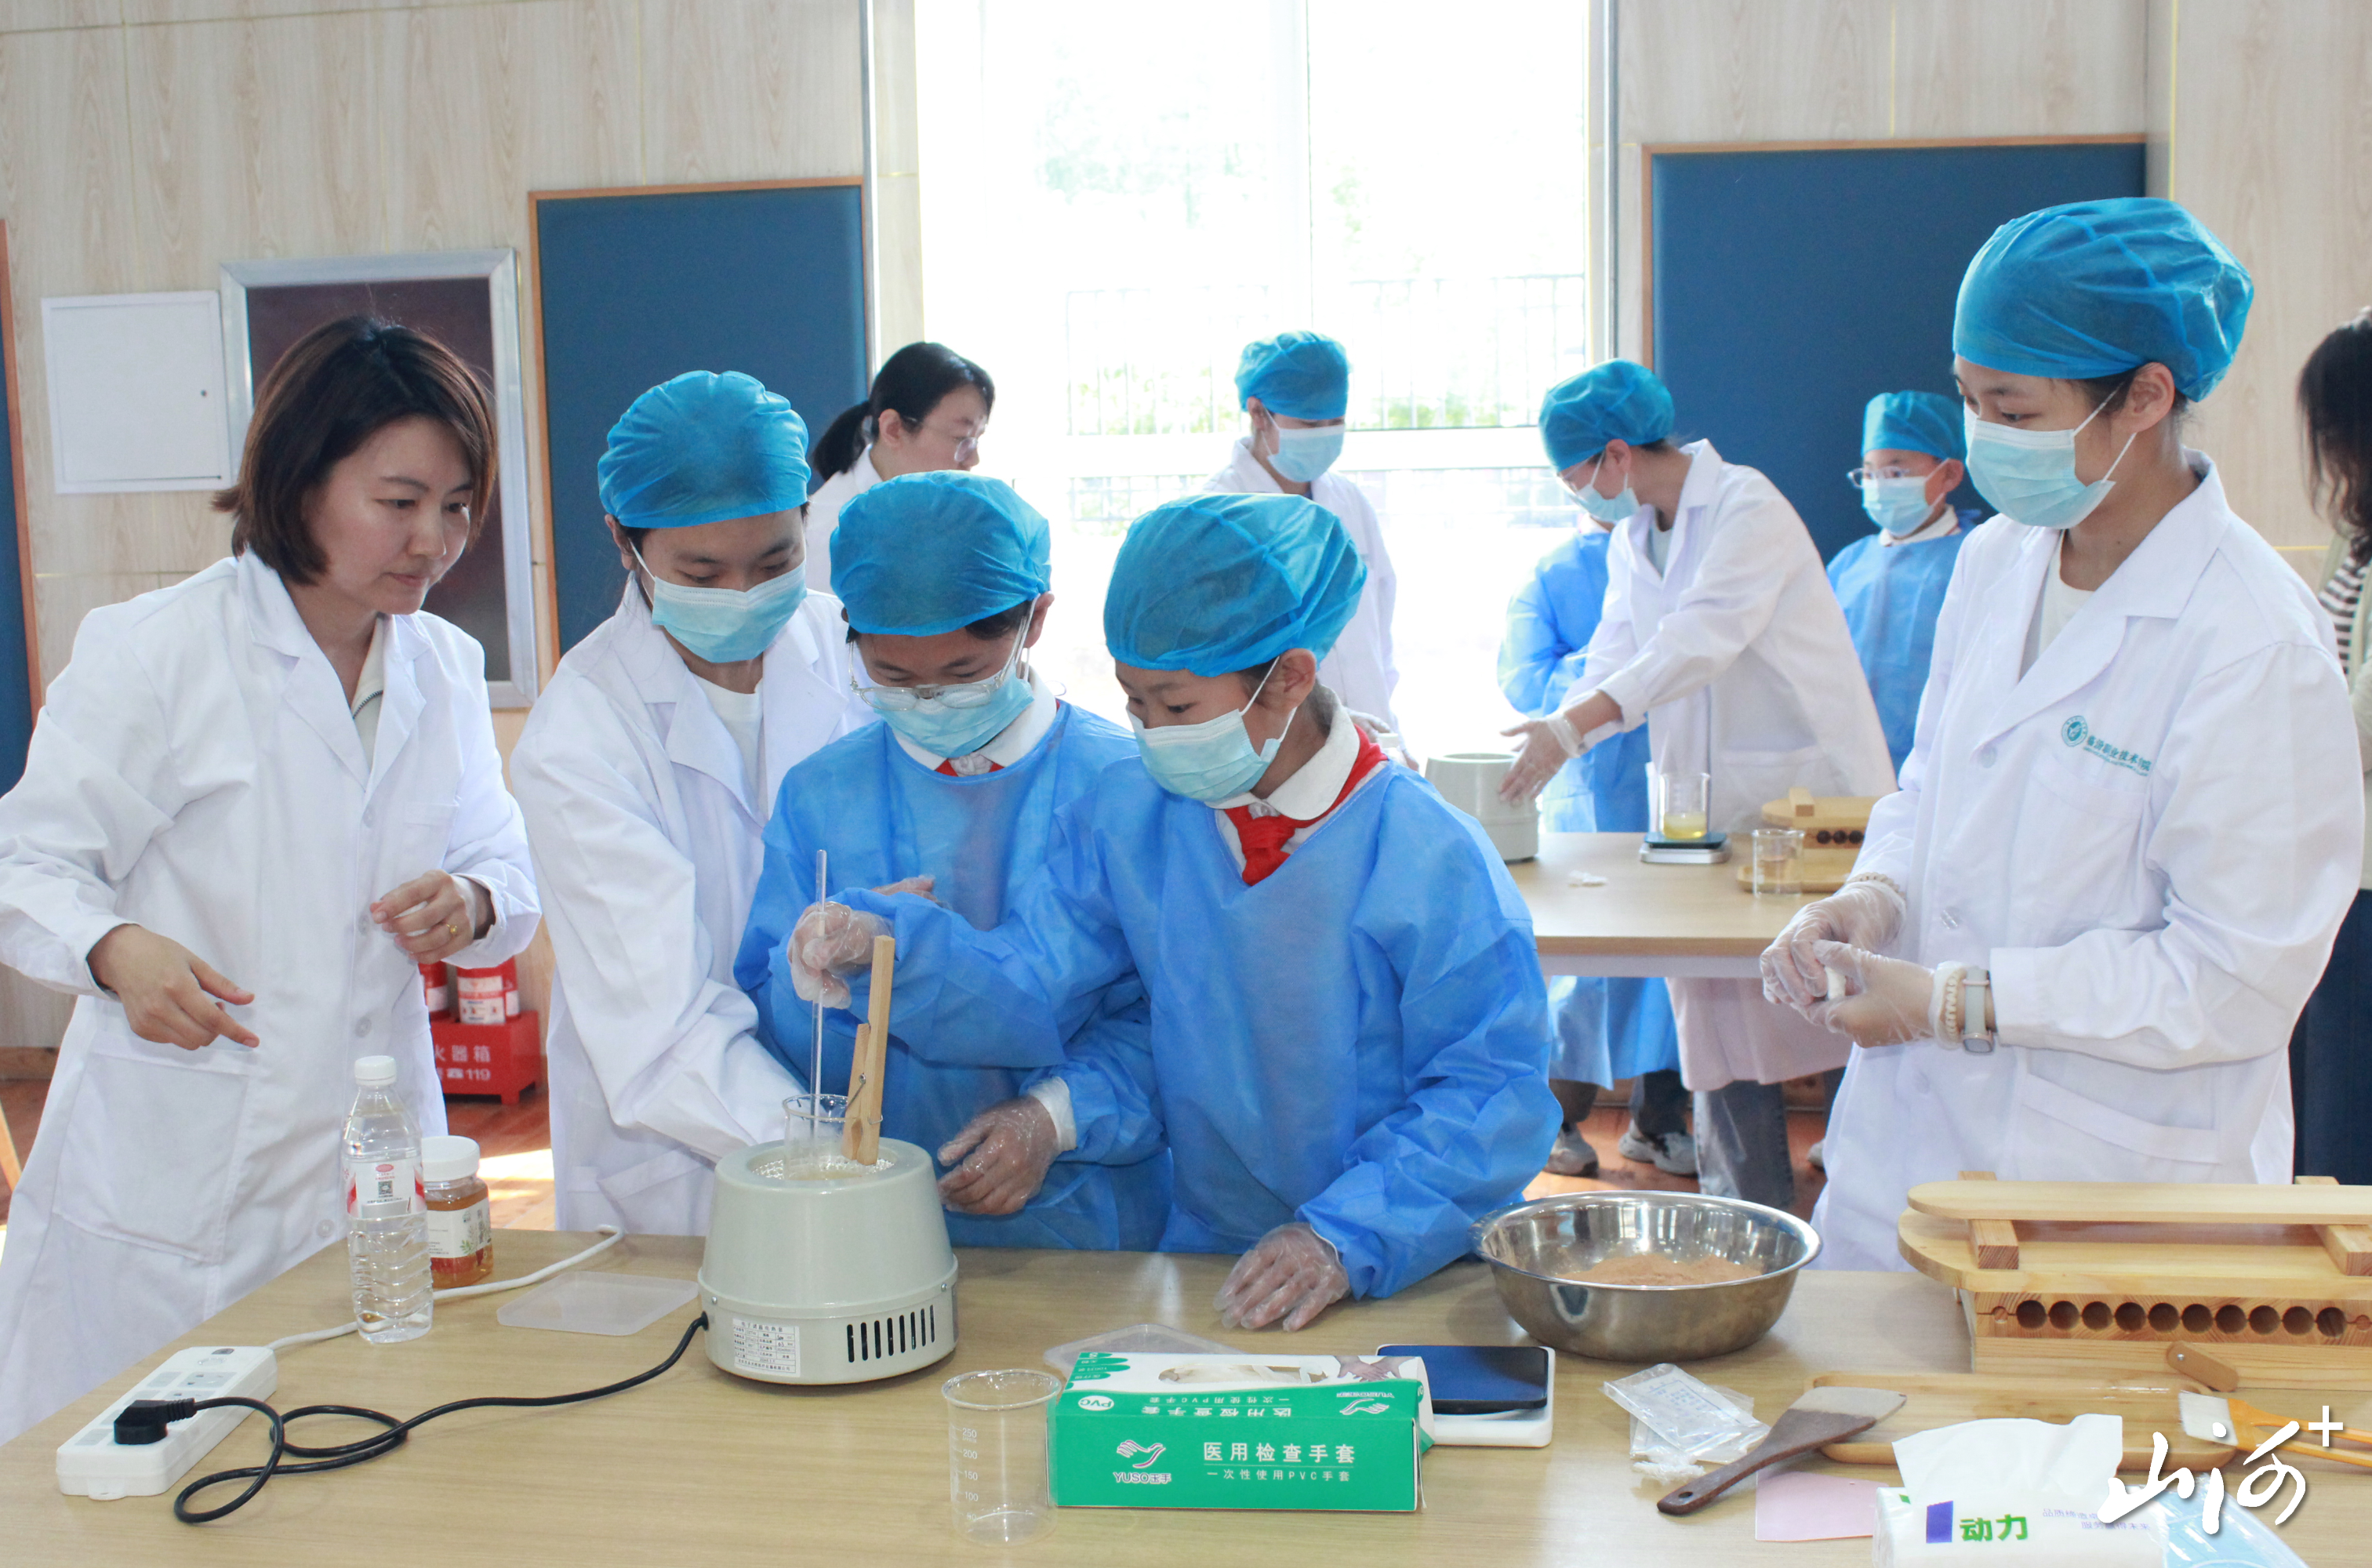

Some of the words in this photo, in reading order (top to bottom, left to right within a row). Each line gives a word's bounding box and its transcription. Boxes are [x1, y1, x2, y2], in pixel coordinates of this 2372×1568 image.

[1079, 1399, 1112, 1408] PVC
[962, 1427, 977, 1438] 250
[963, 1449, 978, 1459] 200
[1204, 1442, 1355, 1464] 医用检查手套
[964, 1471, 978, 1480] 150
[1207, 1468, 1350, 1482] 一次性使用PVC手套
[964, 1491, 979, 1501] 100
[1960, 1513, 2029, 1542] 动力
